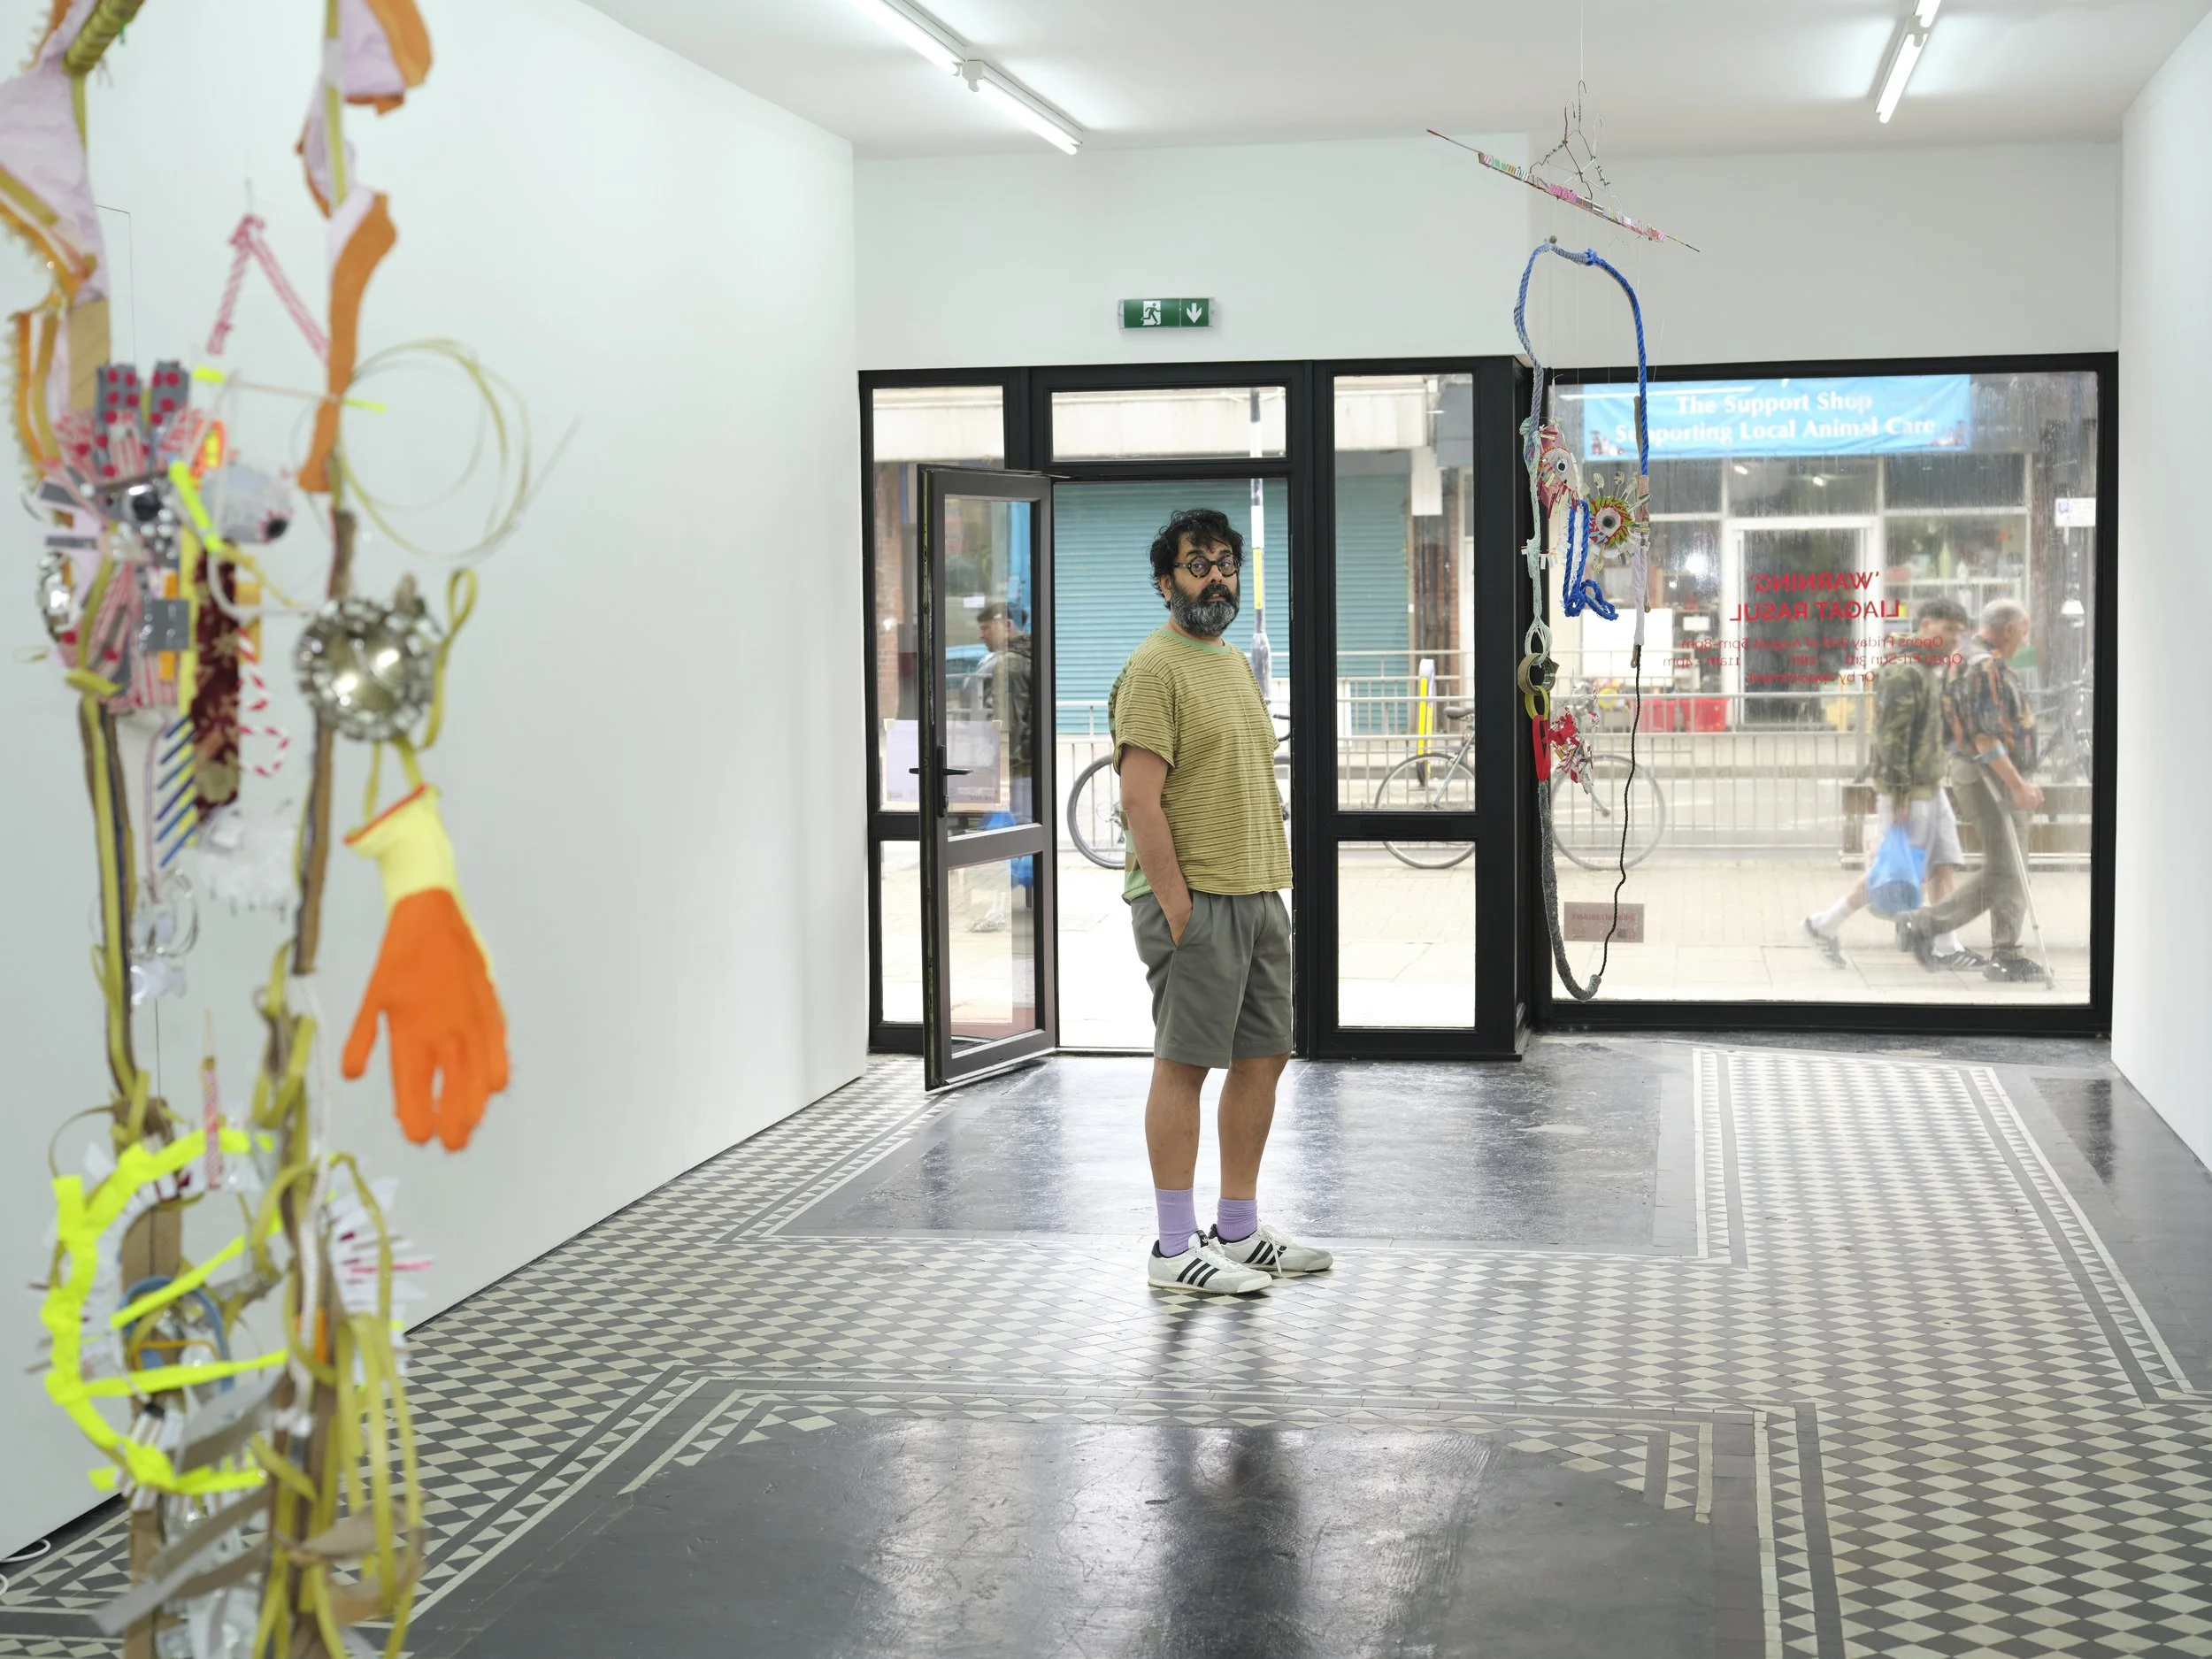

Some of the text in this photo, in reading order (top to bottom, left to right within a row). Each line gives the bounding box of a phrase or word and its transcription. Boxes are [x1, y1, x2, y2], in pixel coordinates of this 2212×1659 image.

[1677, 390, 1873, 418] The Support Shop
[1740, 418, 1796, 440] Local
[1801, 416, 1878, 437] Animal
[1886, 416, 1936, 435] Care
